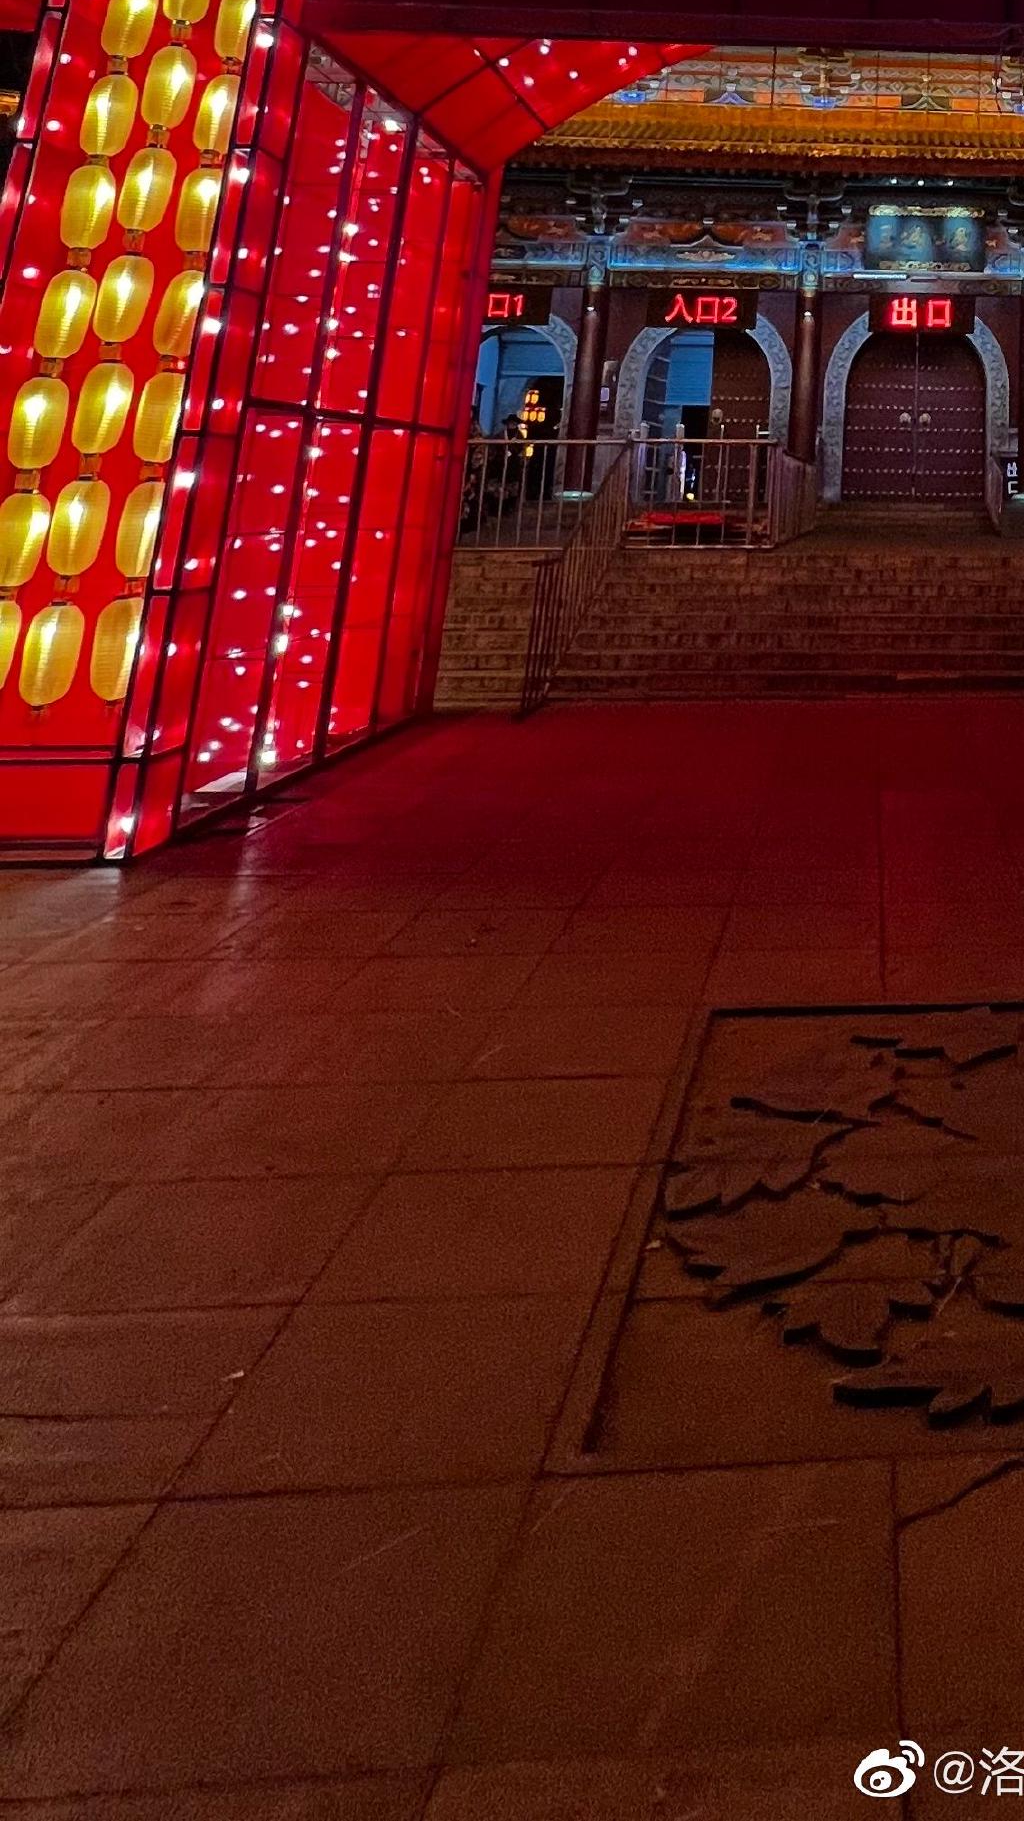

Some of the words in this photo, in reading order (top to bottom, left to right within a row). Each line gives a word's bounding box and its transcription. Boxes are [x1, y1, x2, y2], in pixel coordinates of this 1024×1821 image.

[487, 293, 524, 318] 口1
[665, 293, 738, 323] 入口2
[890, 297, 952, 328] 出口
